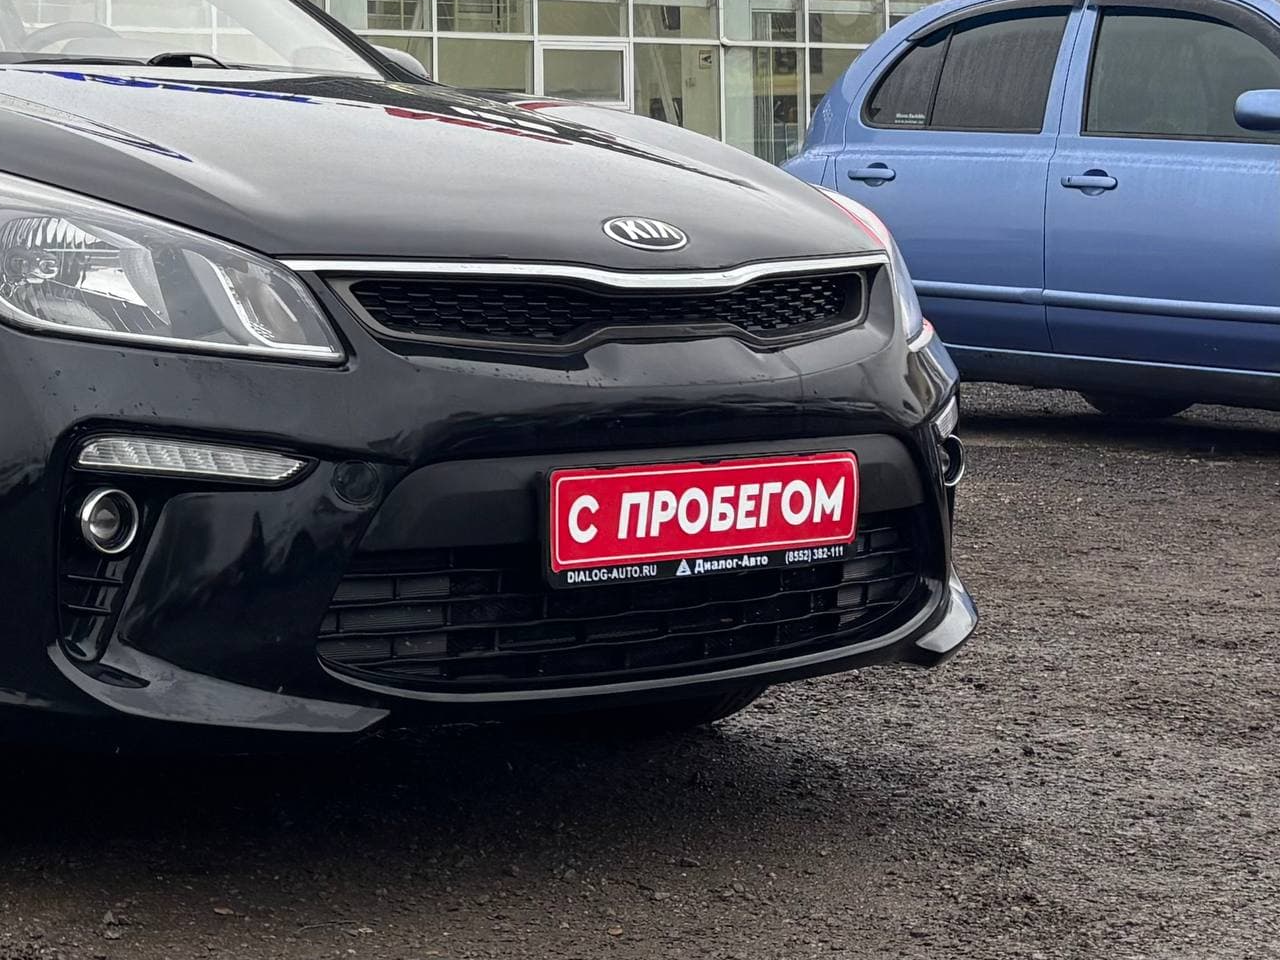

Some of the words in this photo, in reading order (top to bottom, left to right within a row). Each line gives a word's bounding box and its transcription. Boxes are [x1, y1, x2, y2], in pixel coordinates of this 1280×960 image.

[568, 495, 600, 544] С
[617, 476, 846, 540] ПРОБЕГОМ
[694, 554, 769, 574] Диалог-Авто
[785, 548, 811, 565] (8552)
[812, 545, 844, 559] 382-111
[567, 564, 657, 583] DIALOG-AUTO.RU
